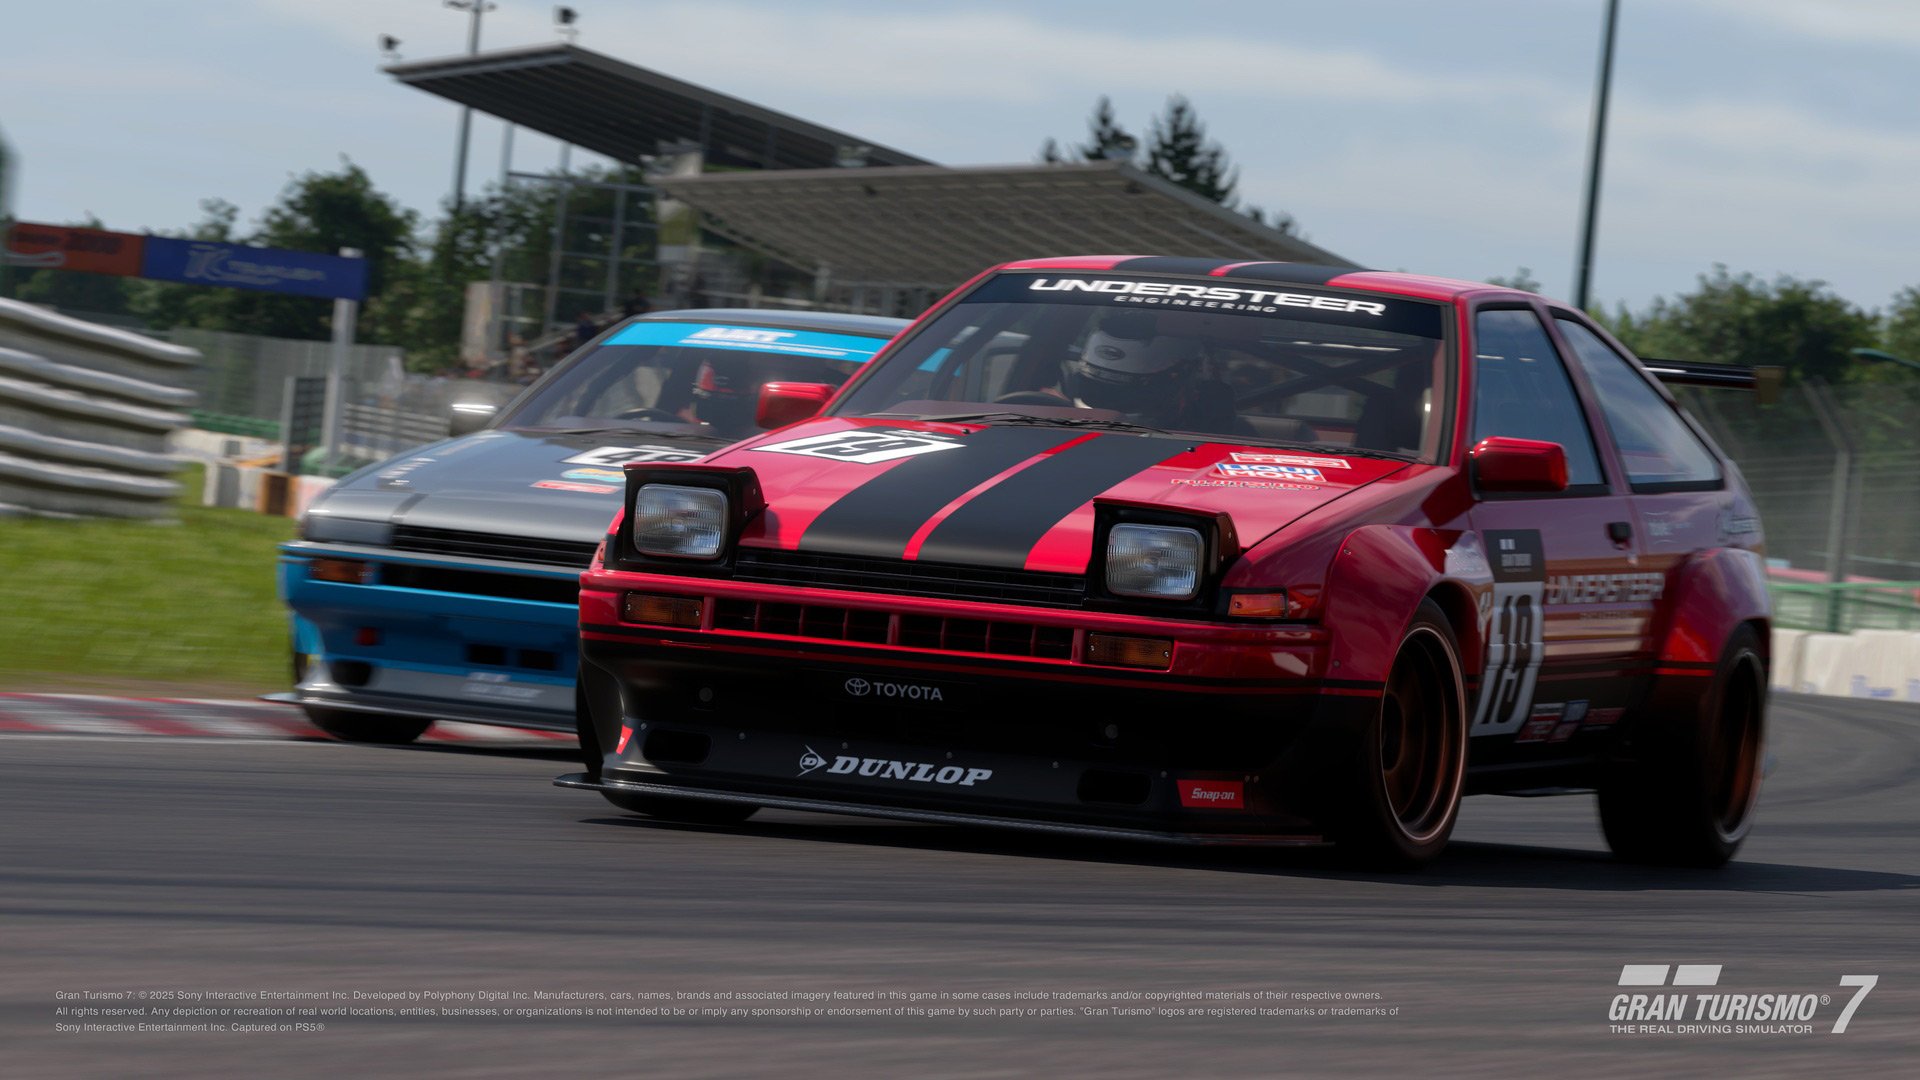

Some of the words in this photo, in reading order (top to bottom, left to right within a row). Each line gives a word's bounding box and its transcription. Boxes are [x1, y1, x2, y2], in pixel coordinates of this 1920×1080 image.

[1029, 278, 1387, 317] UNDERSTEER
[1113, 295, 1279, 314] ENGINEERING
[780, 435, 934, 457] 19
[1220, 463, 1314, 476] LIQUI
[1226, 469, 1318, 482] MOLY
[1480, 593, 1534, 725] 19
[873, 681, 944, 702] TOYOTA
[826, 755, 993, 787] DUNLOP
[1191, 787, 1235, 802] Snap-on
